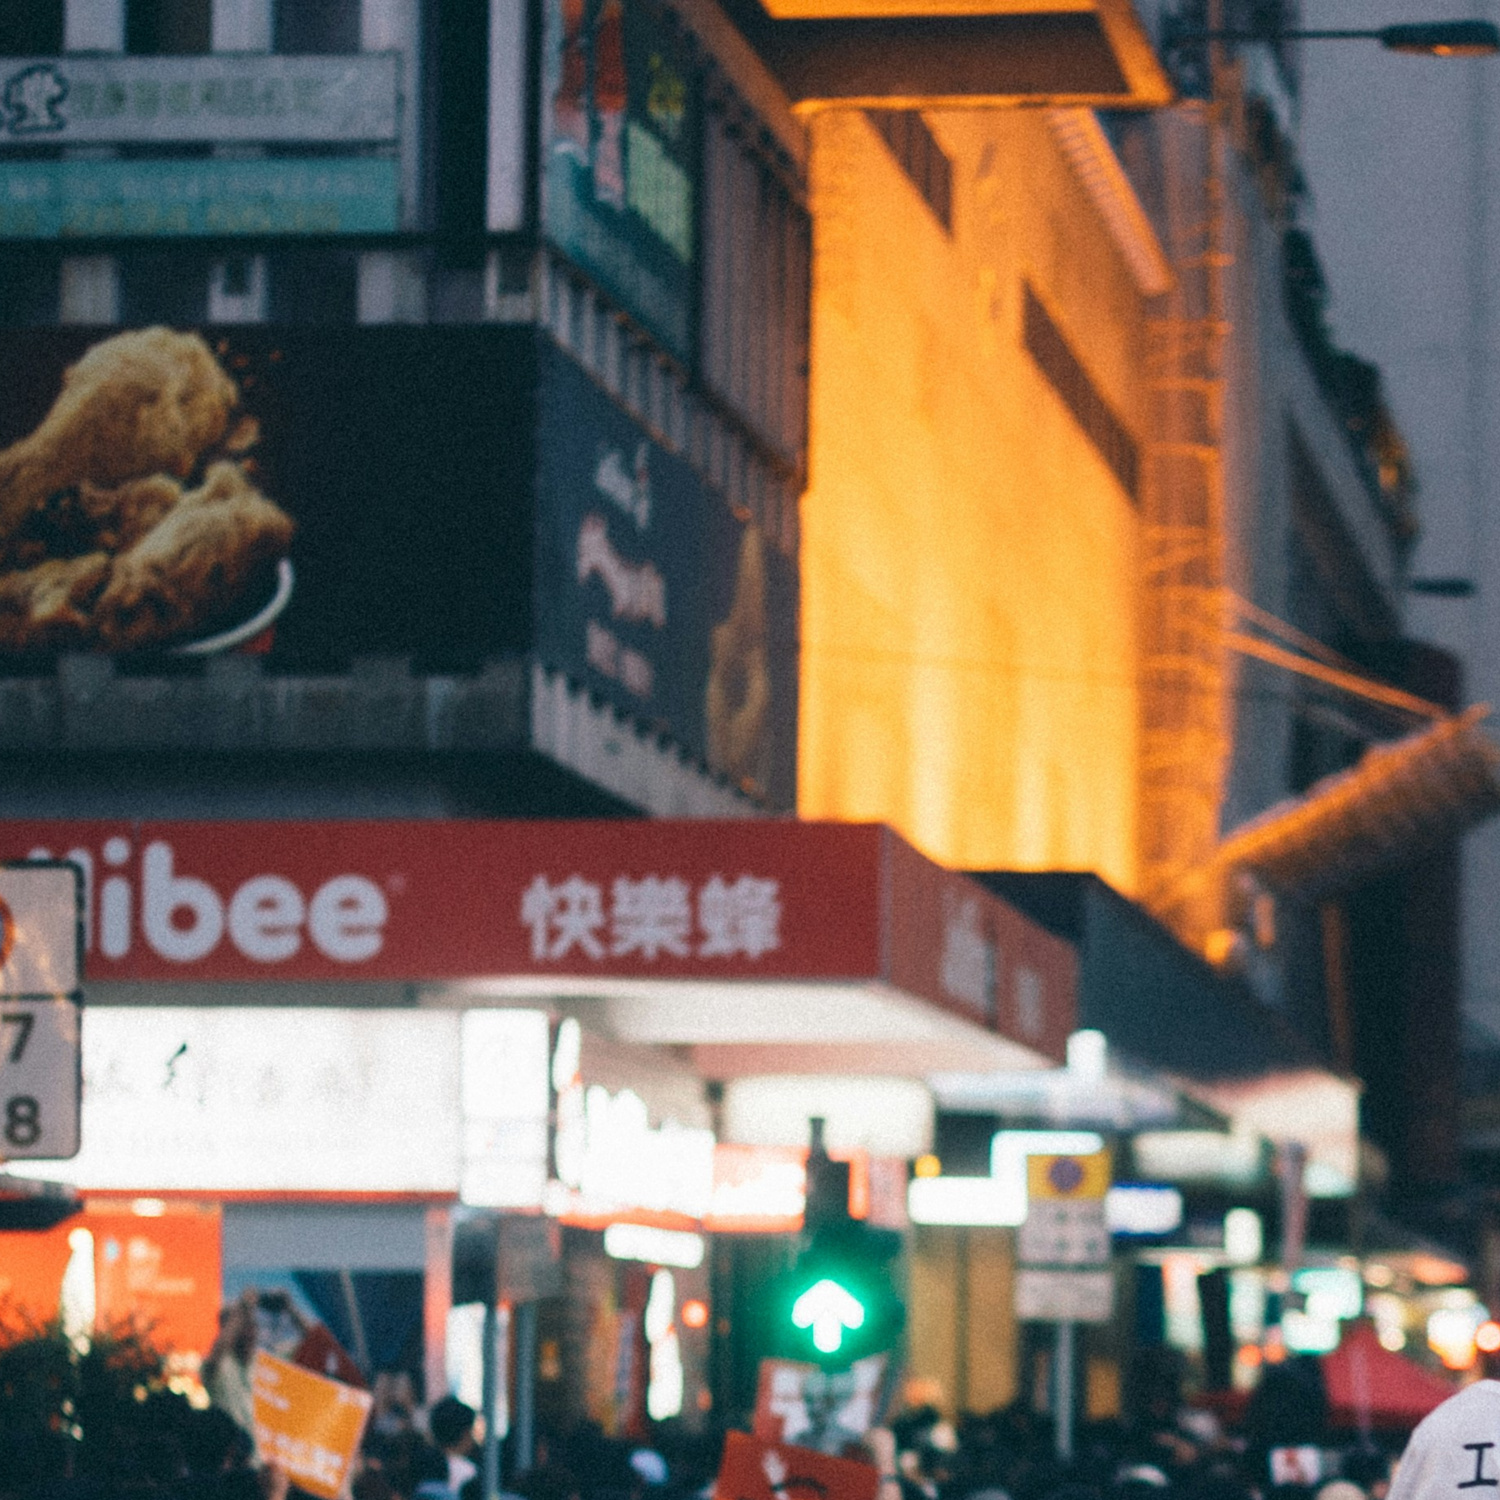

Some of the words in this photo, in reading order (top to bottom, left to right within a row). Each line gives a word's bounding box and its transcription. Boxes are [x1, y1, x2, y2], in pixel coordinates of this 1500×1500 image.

[28, 836, 390, 963] ibee
[521, 874, 781, 960] 快樂蜂
[2, 1014, 34, 1064] 7
[5, 1094, 41, 1147] 8
[1457, 1442, 1498, 1489] I
